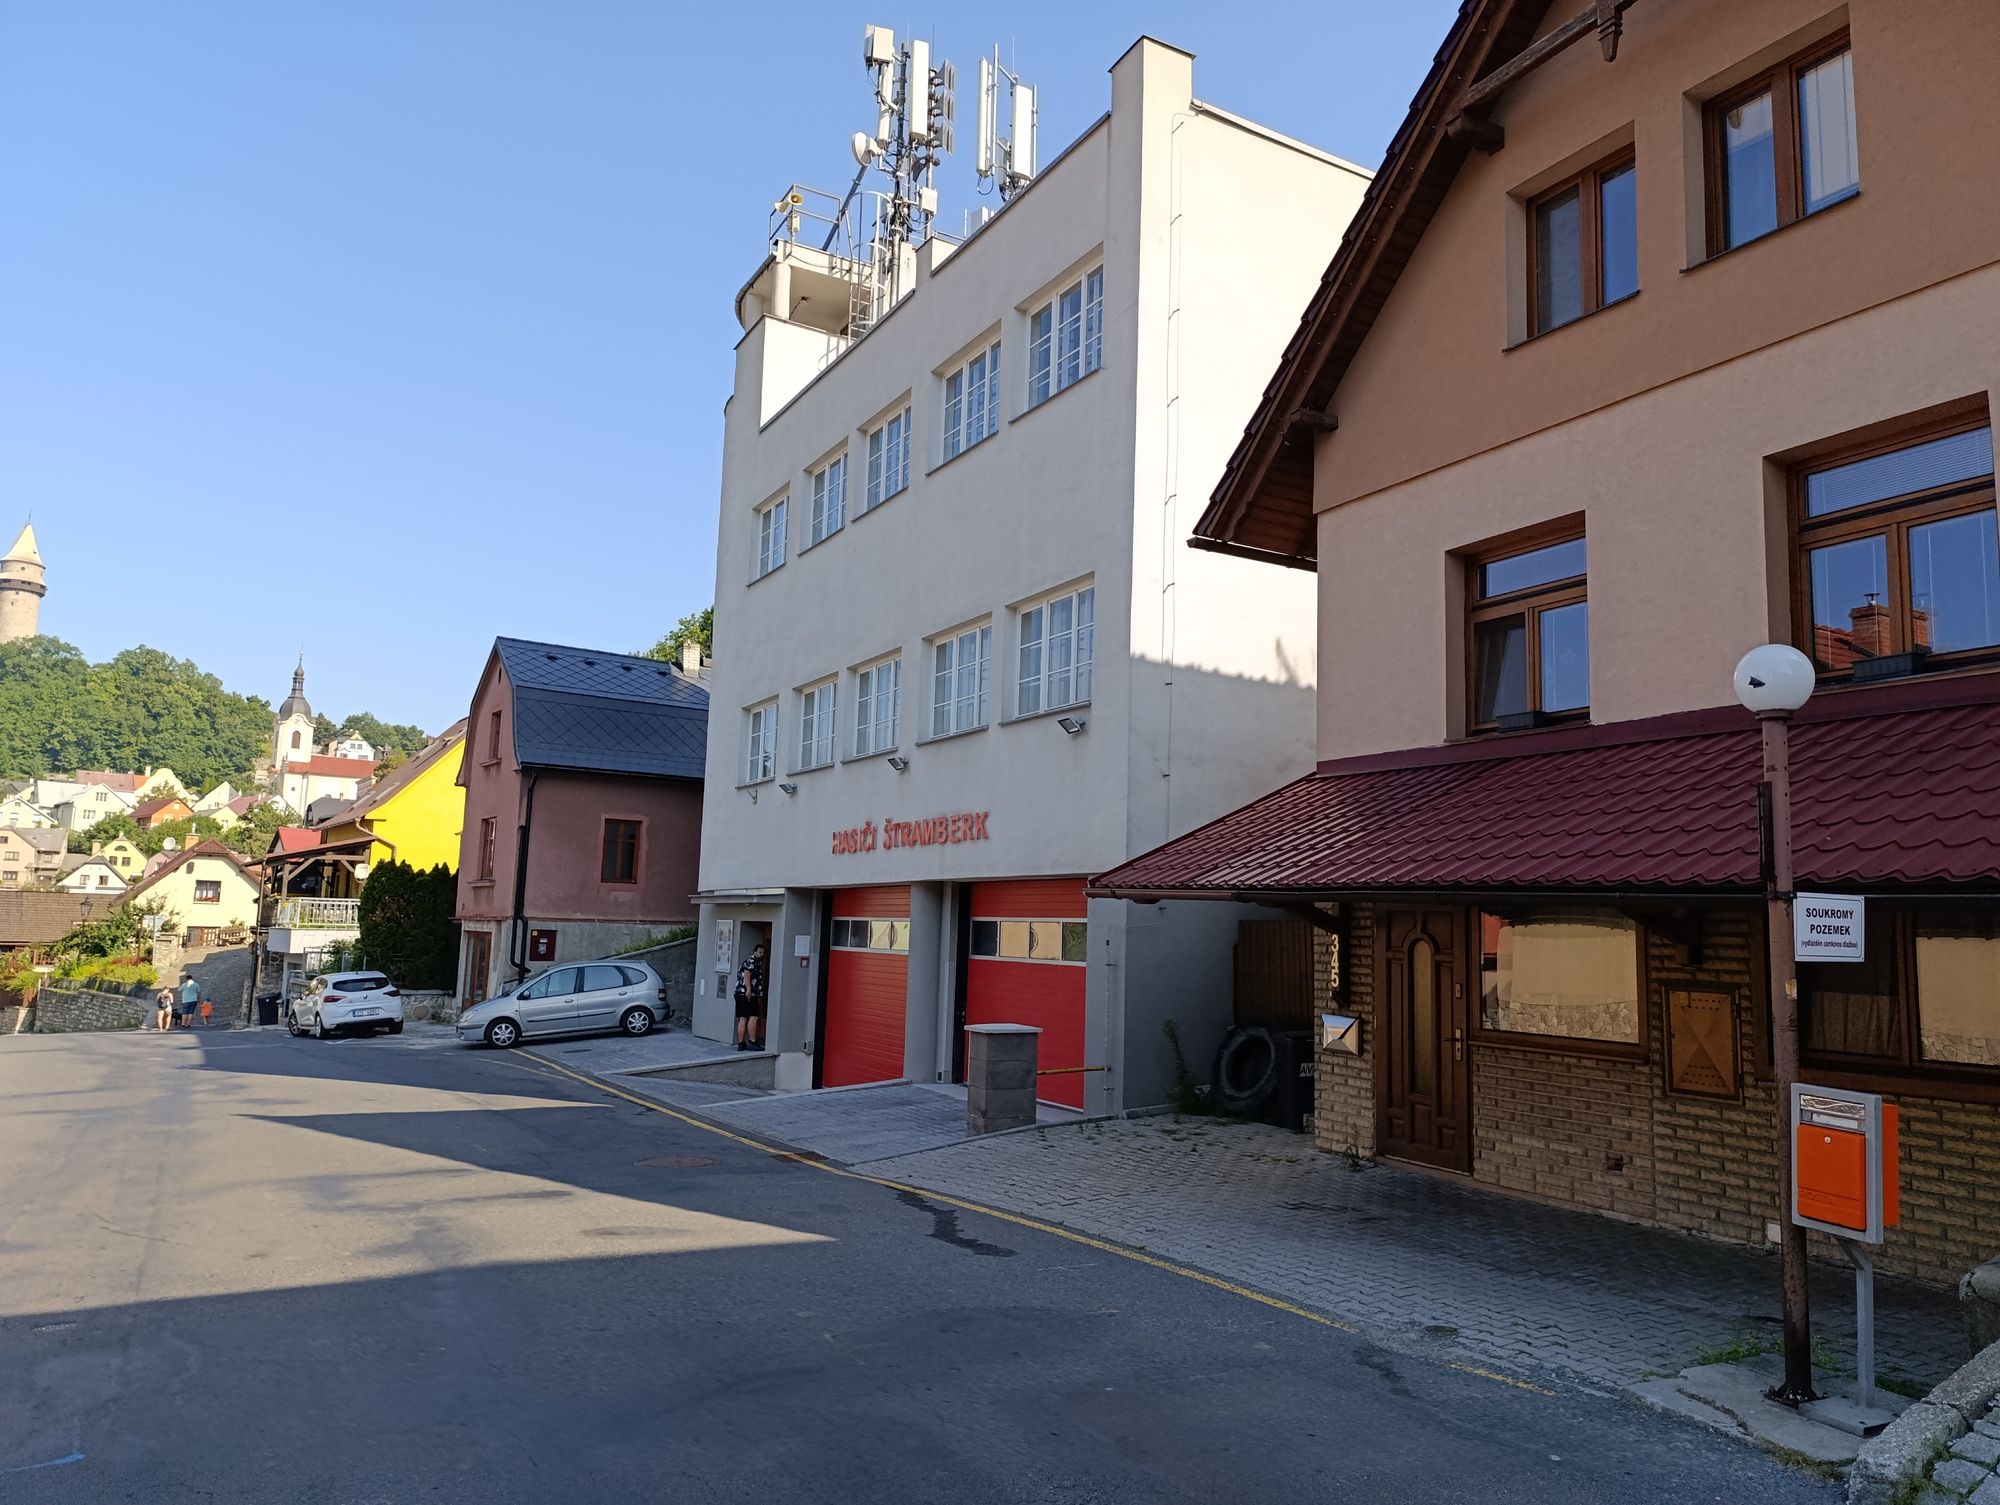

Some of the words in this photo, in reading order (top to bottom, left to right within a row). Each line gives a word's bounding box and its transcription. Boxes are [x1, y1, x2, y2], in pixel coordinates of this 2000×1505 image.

[832, 820, 878, 855] HASIČI
[883, 811, 990, 850] ŠTRAMBERK
[1805, 907, 1854, 920] SOUKROMÝ
[1810, 924, 1851, 936] POZEMEK
[1331, 934, 1339, 988] 345
